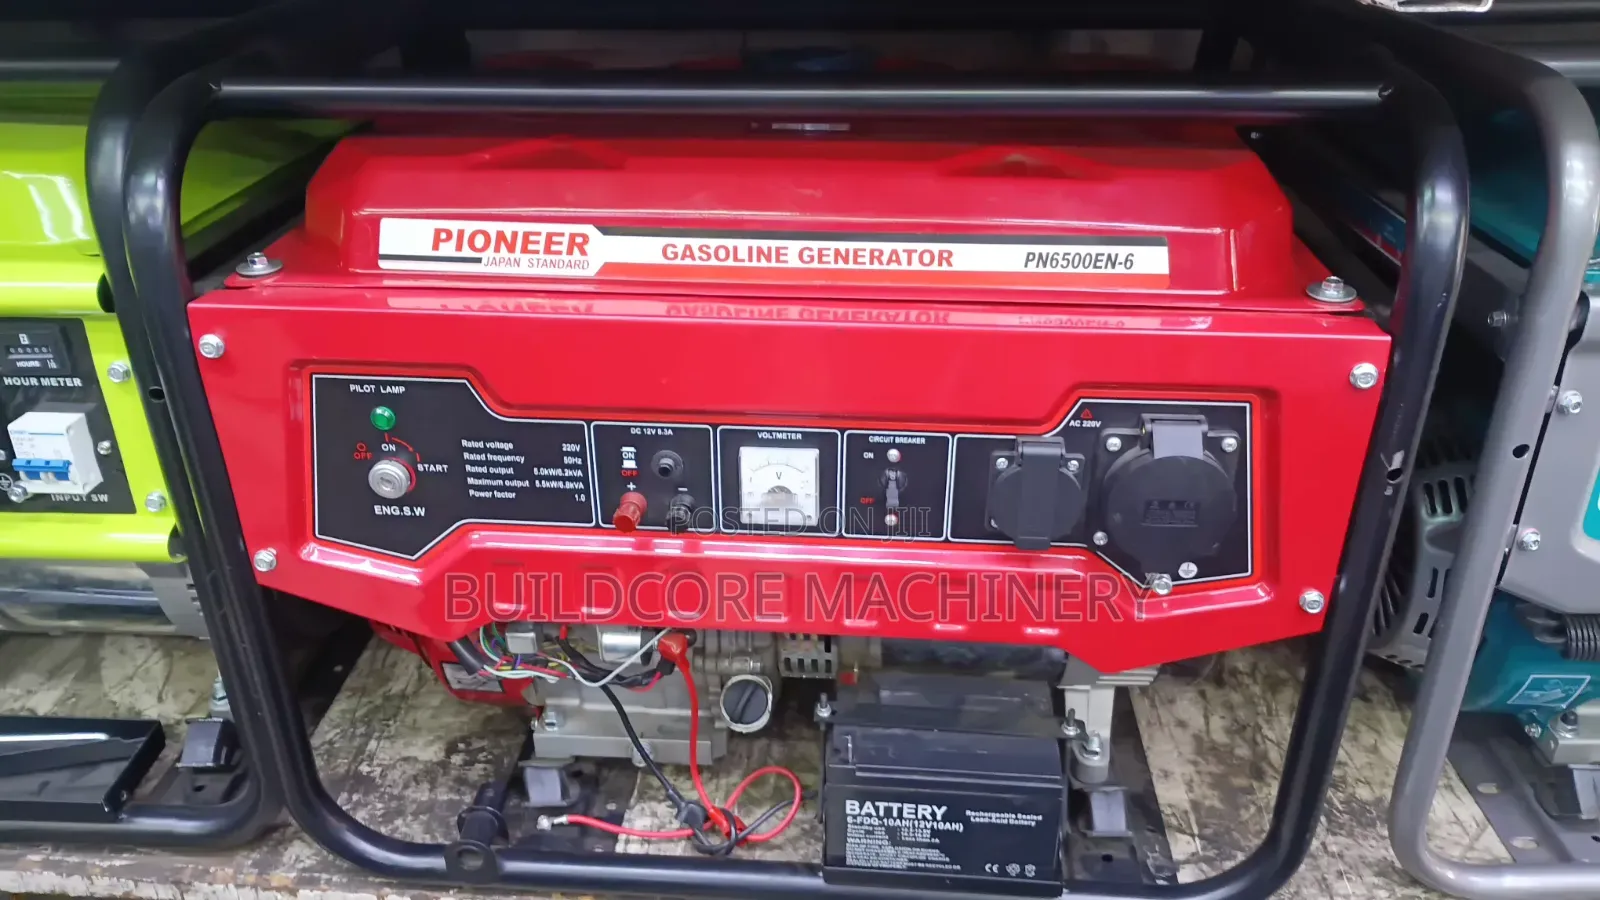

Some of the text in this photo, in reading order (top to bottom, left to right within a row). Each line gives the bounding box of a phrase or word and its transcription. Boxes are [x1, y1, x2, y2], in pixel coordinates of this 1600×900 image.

[432, 228, 590, 256] PIONEER
[662, 244, 953, 267] GASOLINE GENERATOR
[1024, 252, 1134, 270] PN6500EN-6
[484, 257, 590, 270] JAPAN STANDARD
[3, 376, 82, 387] HOUR METER
[350, 384, 405, 394] PILOT LAMP
[1082, 420, 1101, 428] 220V
[757, 432, 802, 440] VOLTMETER
[895, 436, 926, 444] BREAKER
[382, 443, 396, 452] ON
[462, 440, 580, 452] Rated voltage 220V
[354, 452, 372, 460] OFF
[464, 452, 582, 465] Rated frequency 50Hz
[417, 464, 448, 472] START
[465, 464, 487, 473] Rated
[490, 466, 514, 475] output
[776, 472, 782, 480] V
[467, 477, 503, 486] Maximum
[505, 479, 530, 488] output
[51, 494, 108, 502] INPUT SW
[469, 489, 586, 502] Power factor 1.0
[374, 504, 426, 516] ENG.S.W
[846, 800, 948, 821] BATTERY
[966, 810, 1016, 819] Rechargeable
